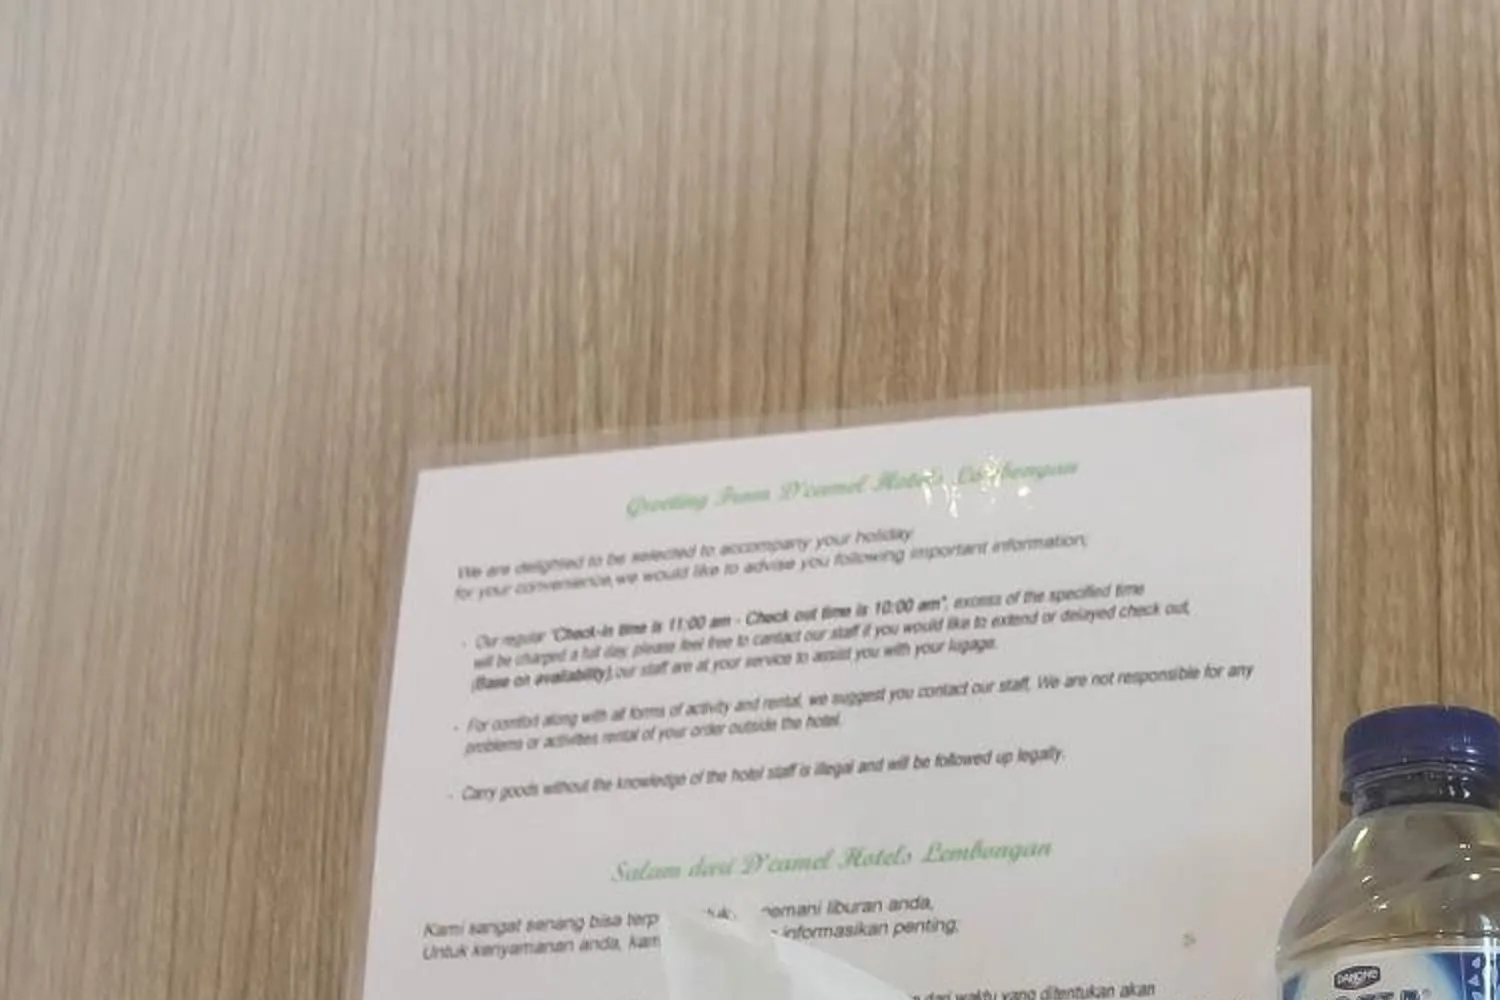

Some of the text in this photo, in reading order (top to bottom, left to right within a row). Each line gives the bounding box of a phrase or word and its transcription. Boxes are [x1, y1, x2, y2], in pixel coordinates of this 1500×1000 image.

[458, 566, 483, 580] We
[485, 564, 511, 578] are
[587, 555, 604, 568] to
[606, 552, 626, 567] be
[630, 544, 697, 564] selected
[699, 544, 716, 558] to
[719, 537, 813, 557] accompany
[814, 533, 852, 552] your
[478, 541, 989, 601] your would like to advise you following important
[618, 622, 648, 637] time
[669, 614, 707, 632] 11:00
[708, 616, 732, 630] am
[745, 609, 790, 626] Check
[793, 607, 819, 623] out
[821, 605, 852, 621] time
[875, 597, 915, 616] 10:00
[1005, 590, 1022, 606] of
[1023, 590, 1046, 604] the
[1048, 583, 1112, 605] specified
[1115, 583, 1145, 598] time
[514, 648, 568, 668] charged
[707, 635, 734, 650] free
[736, 634, 750, 648] to
[803, 628, 829, 643] our
[829, 623, 862, 640] staff
[874, 624, 900, 640] you
[902, 617, 945, 635] would
[946, 616, 971, 631] like
[973, 615, 988, 630] to
[990, 610, 1039, 629] extend
[1041, 611, 1057, 625] or
[1059, 604, 1117, 624] delayed
[1118, 602, 1160, 619] check
[512, 641, 946, 688] on staff are your service to you with your
[466, 717, 490, 734] For
[541, 713, 579, 730] along
[581, 708, 608, 724] with
[669, 701, 685, 718] of
[685, 699, 732, 717] activity
[733, 696, 761, 713] and
[888, 687, 915, 705] you
[917, 680, 970, 699] contact
[971, 680, 996, 696] our
[1037, 674, 1061, 689] We
[1063, 674, 1088, 689] are
[1091, 671, 1115, 686] not
[1117, 665, 1201, 687] responsible
[1203, 663, 1225, 679] for
[1227, 664, 1255, 680] any
[641, 724, 657, 742] of
[658, 726, 689, 743] your
[689, 722, 727, 738] order
[728, 717, 778, 736] outside
[780, 716, 803, 731] the
[461, 785, 498, 802] Carry
[499, 782, 539, 803] goods
[542, 779, 590, 796] without
[591, 777, 614, 793] the
[616, 773, 688, 791] knowledge
[689, 769, 705, 786] of
[706, 769, 728, 785] the
[731, 765, 765, 783] hotel
[766, 762, 800, 780] staff
[856, 757, 885, 774] and
[887, 755, 911, 771] will
[912, 754, 931, 770] be
[934, 749, 993, 768] followed
[995, 751, 1014, 768] up
[611, 859, 681, 881] Salam
[920, 839, 1052, 865] Lembongan
[422, 943, 469, 961] Untuk
[471, 939, 575, 960] kenyamanan
[781, 922, 889, 940] informasikan
[423, 923, 465, 938] Kami
[468, 918, 523, 938] sangat
[525, 916, 586, 934] senang
[588, 914, 623, 929] bisa
[826, 899, 883, 916] liburan
[1119, 981, 1156, 999] akan
